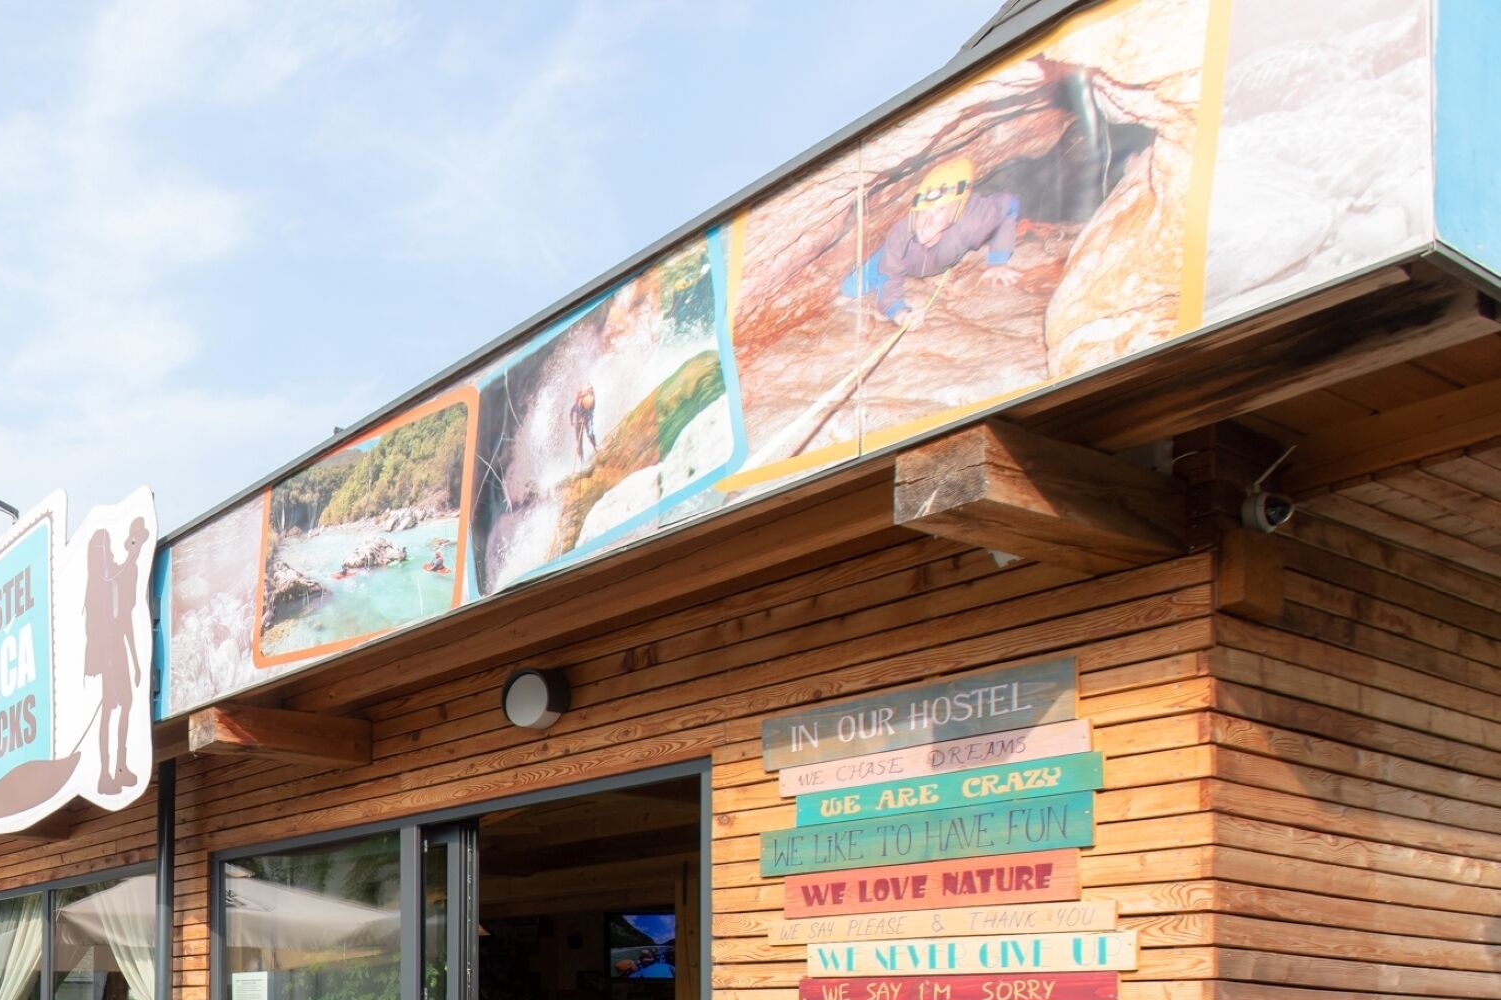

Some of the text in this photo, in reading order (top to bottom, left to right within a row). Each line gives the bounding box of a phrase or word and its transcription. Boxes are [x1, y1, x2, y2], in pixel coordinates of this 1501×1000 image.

[790, 681, 1032, 752] IN OUR HOSTEL
[798, 736, 1027, 787] WE CHASE DREAMS
[821, 767, 1062, 818] WE ARE CRAZY
[774, 835, 803, 867] WE
[878, 823, 912, 857] TO
[925, 813, 995, 852] HAVE
[1007, 804, 1069, 845] FUN
[801, 863, 1054, 907] WE LOVE NATURE
[780, 905, 1097, 941] WE SAY PLEASE & THANK YOU
[817, 935, 1122, 972] WE NEVER GIVE UP
